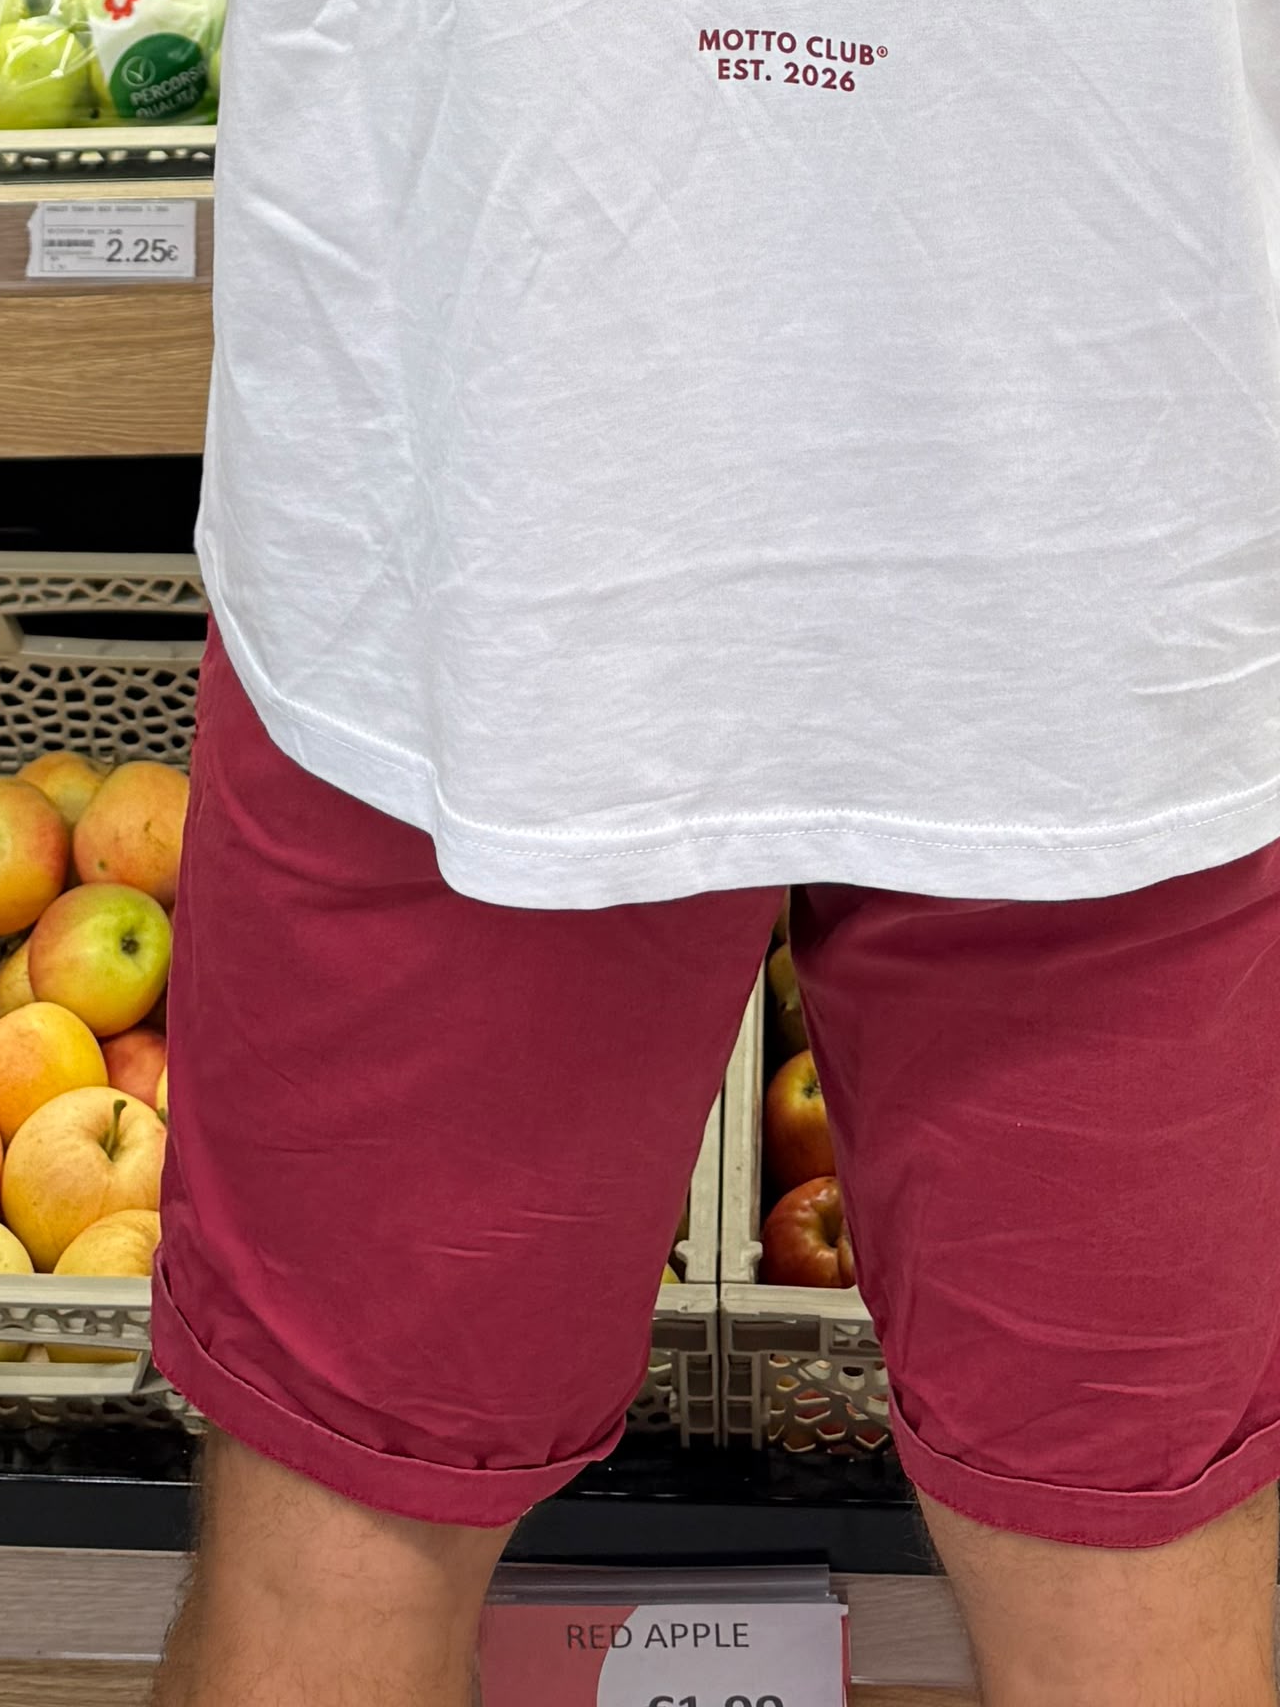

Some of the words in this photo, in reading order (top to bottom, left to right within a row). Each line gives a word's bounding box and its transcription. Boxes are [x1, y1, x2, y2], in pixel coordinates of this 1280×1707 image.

[699, 28, 797, 54] MOTTO
[717, 58, 772, 80] EST.
[783, 61, 856, 92] 2026
[106, 238, 179, 264] 2.25€
[566, 1623, 633, 1650] RED
[644, 1622, 751, 1649] APPLE
